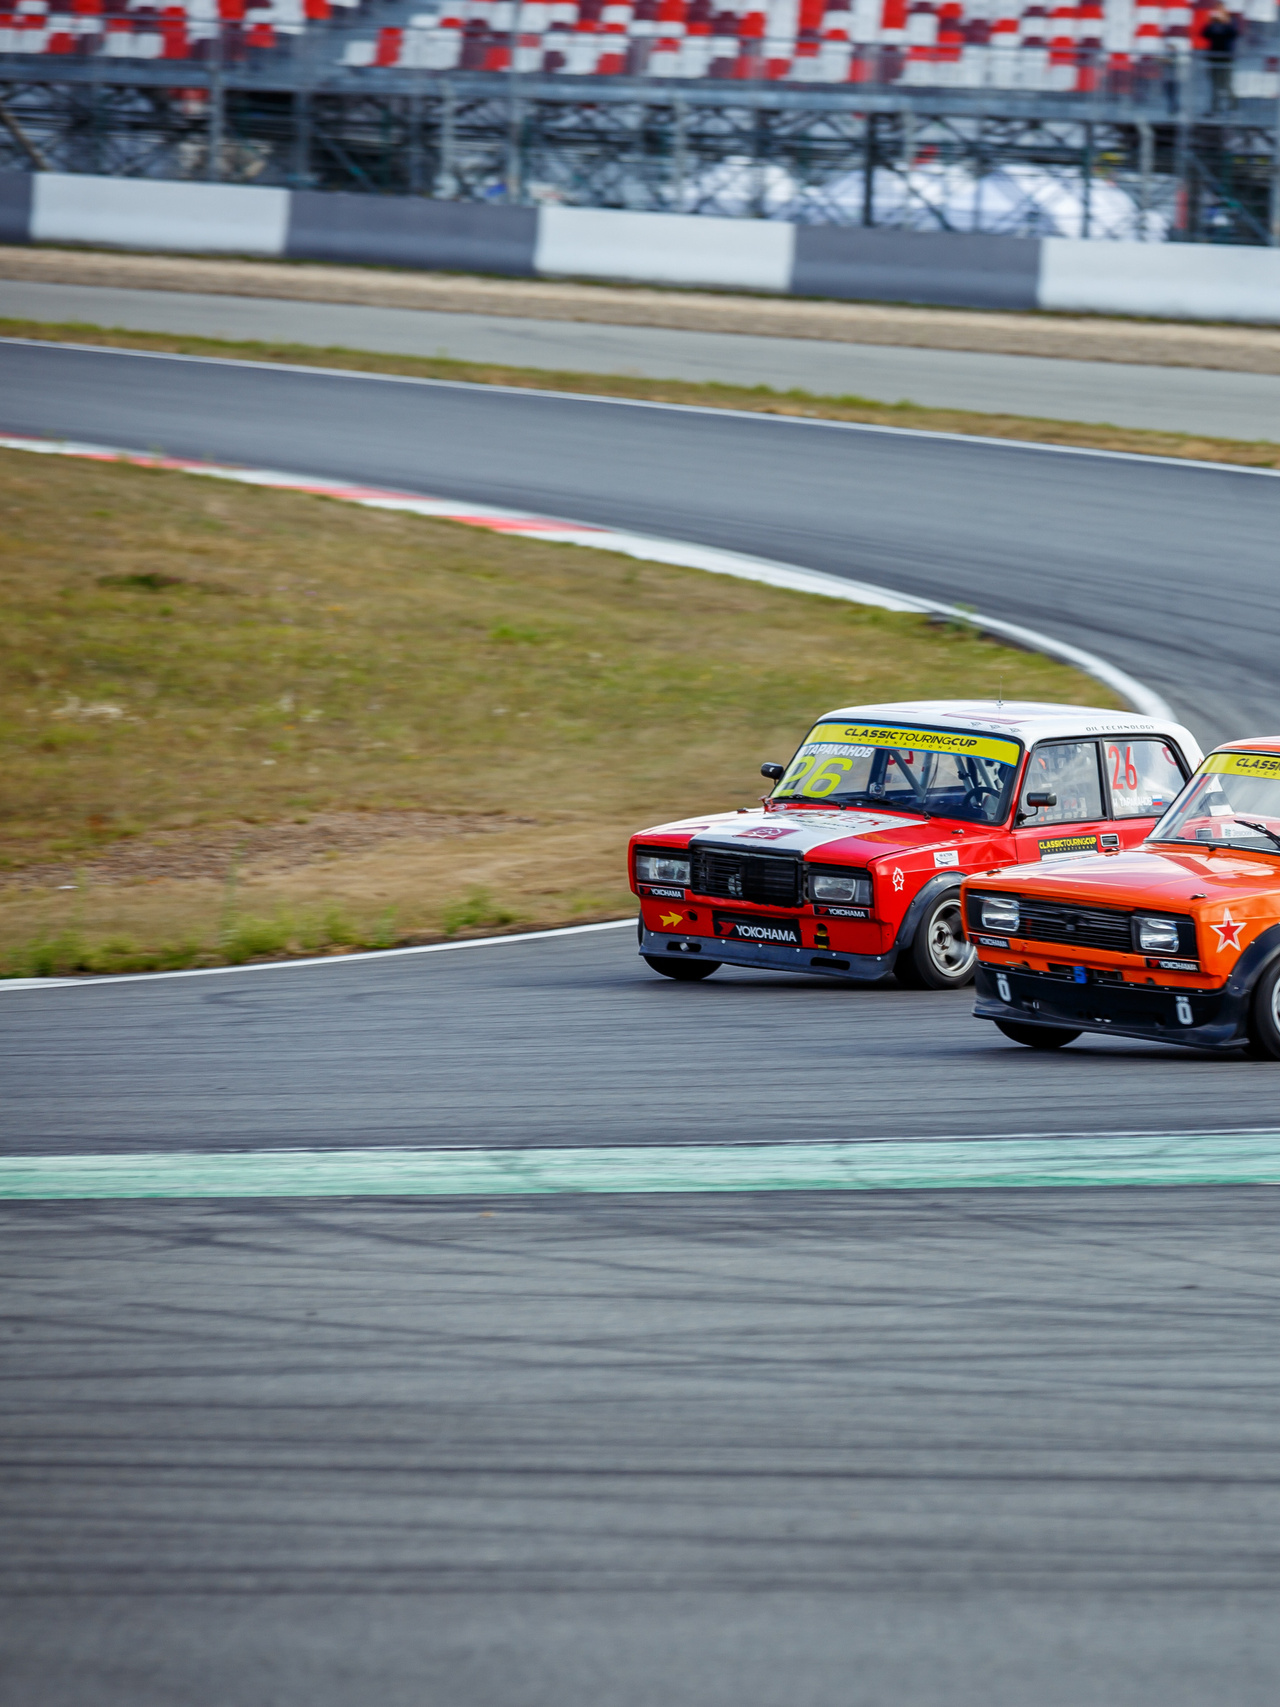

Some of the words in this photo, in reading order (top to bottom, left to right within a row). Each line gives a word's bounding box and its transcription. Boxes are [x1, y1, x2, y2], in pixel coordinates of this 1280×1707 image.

[844, 728, 977, 747] CLASSICTOURINGCUP
[851, 738, 961, 751] INTERNATIONAL
[805, 744, 875, 758] ТАРАКАНОВ
[1108, 745, 1138, 790] 26
[772, 755, 853, 798] 26
[650, 888, 682, 898] YOKOHAMA
[828, 908, 866, 918] YOKOHAMA
[735, 924, 798, 942] YOKOHAMA
